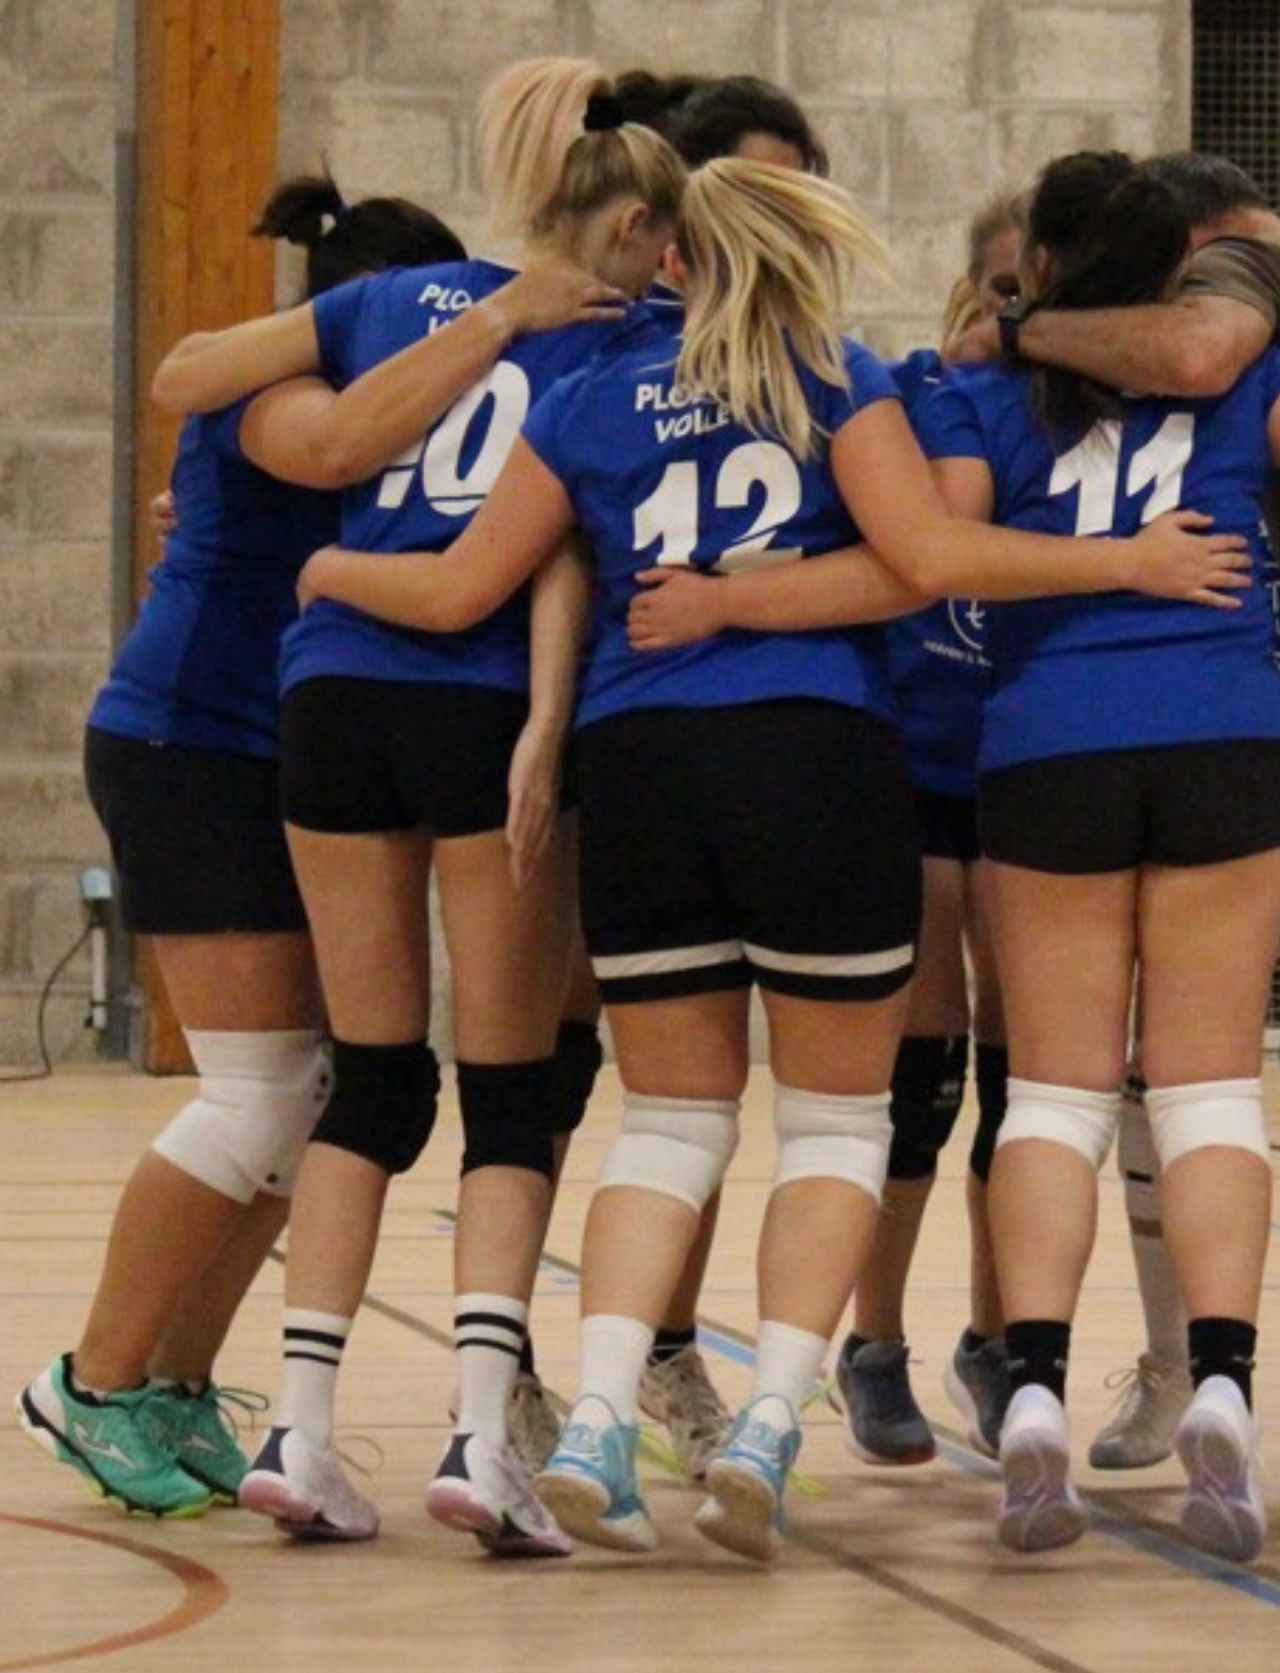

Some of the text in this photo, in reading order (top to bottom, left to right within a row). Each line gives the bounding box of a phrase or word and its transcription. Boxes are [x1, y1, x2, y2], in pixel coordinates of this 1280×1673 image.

[418, 283, 473, 311] PLO
[377, 360, 530, 518] 0
[654, 405, 730, 444] VOLLE
[1047, 412, 1195, 537] 11
[632, 440, 802, 575] 12
